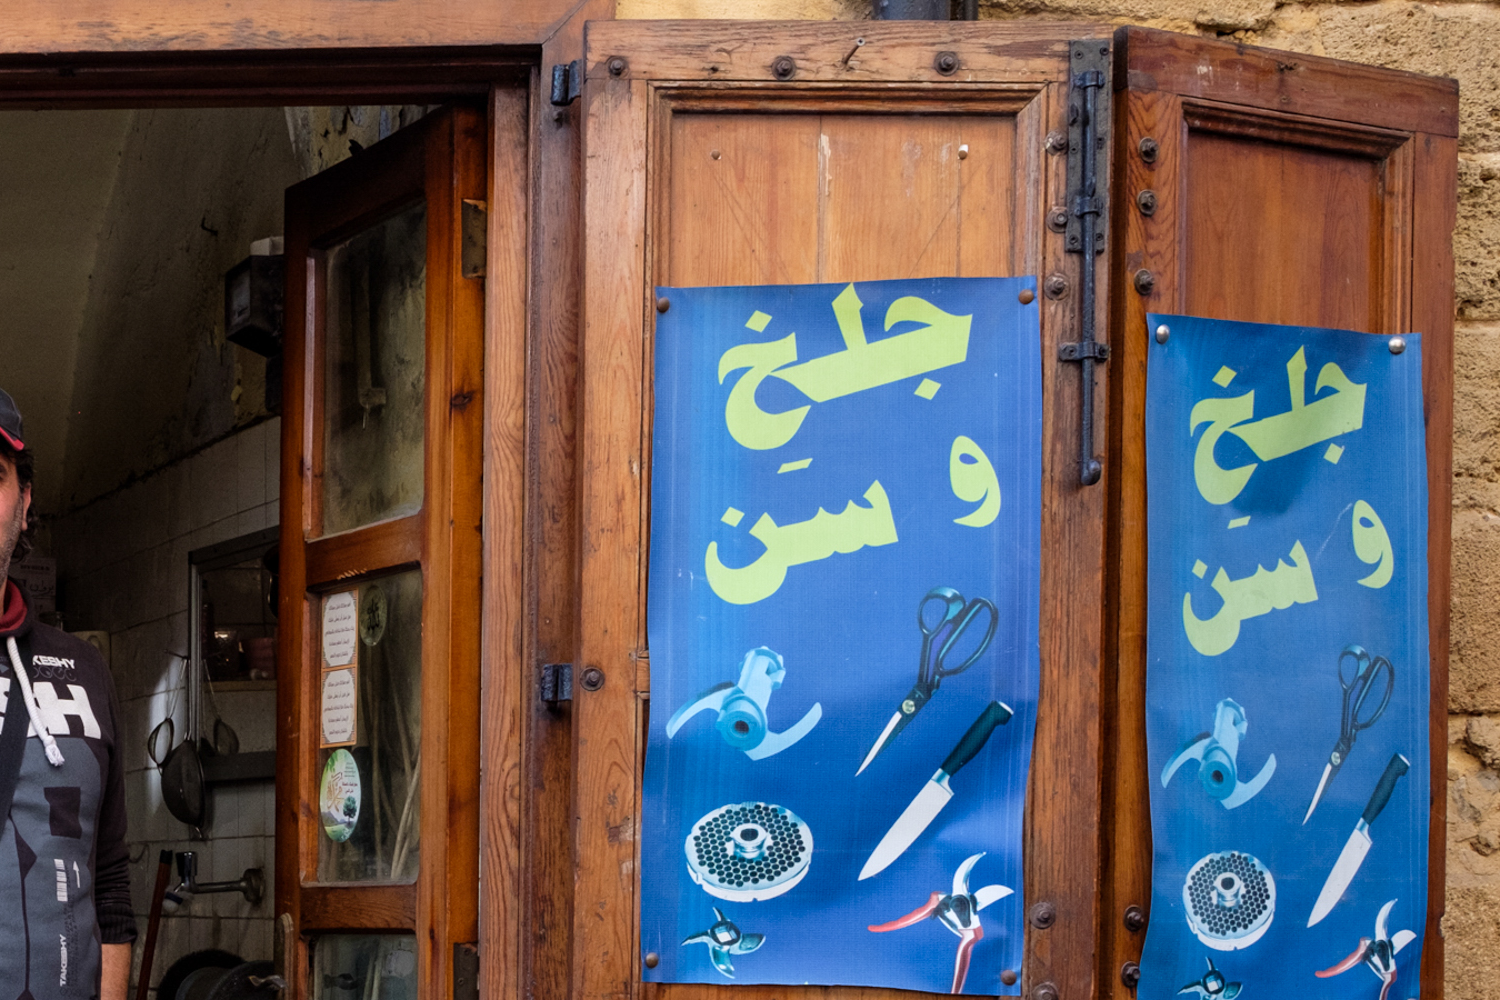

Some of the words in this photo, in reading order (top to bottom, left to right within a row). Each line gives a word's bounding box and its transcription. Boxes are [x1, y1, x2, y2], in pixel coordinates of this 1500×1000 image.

[717, 282, 973, 450] جلخ
[1189, 345, 1367, 506] جلخ
[32, 655, 75, 669] KESHY
